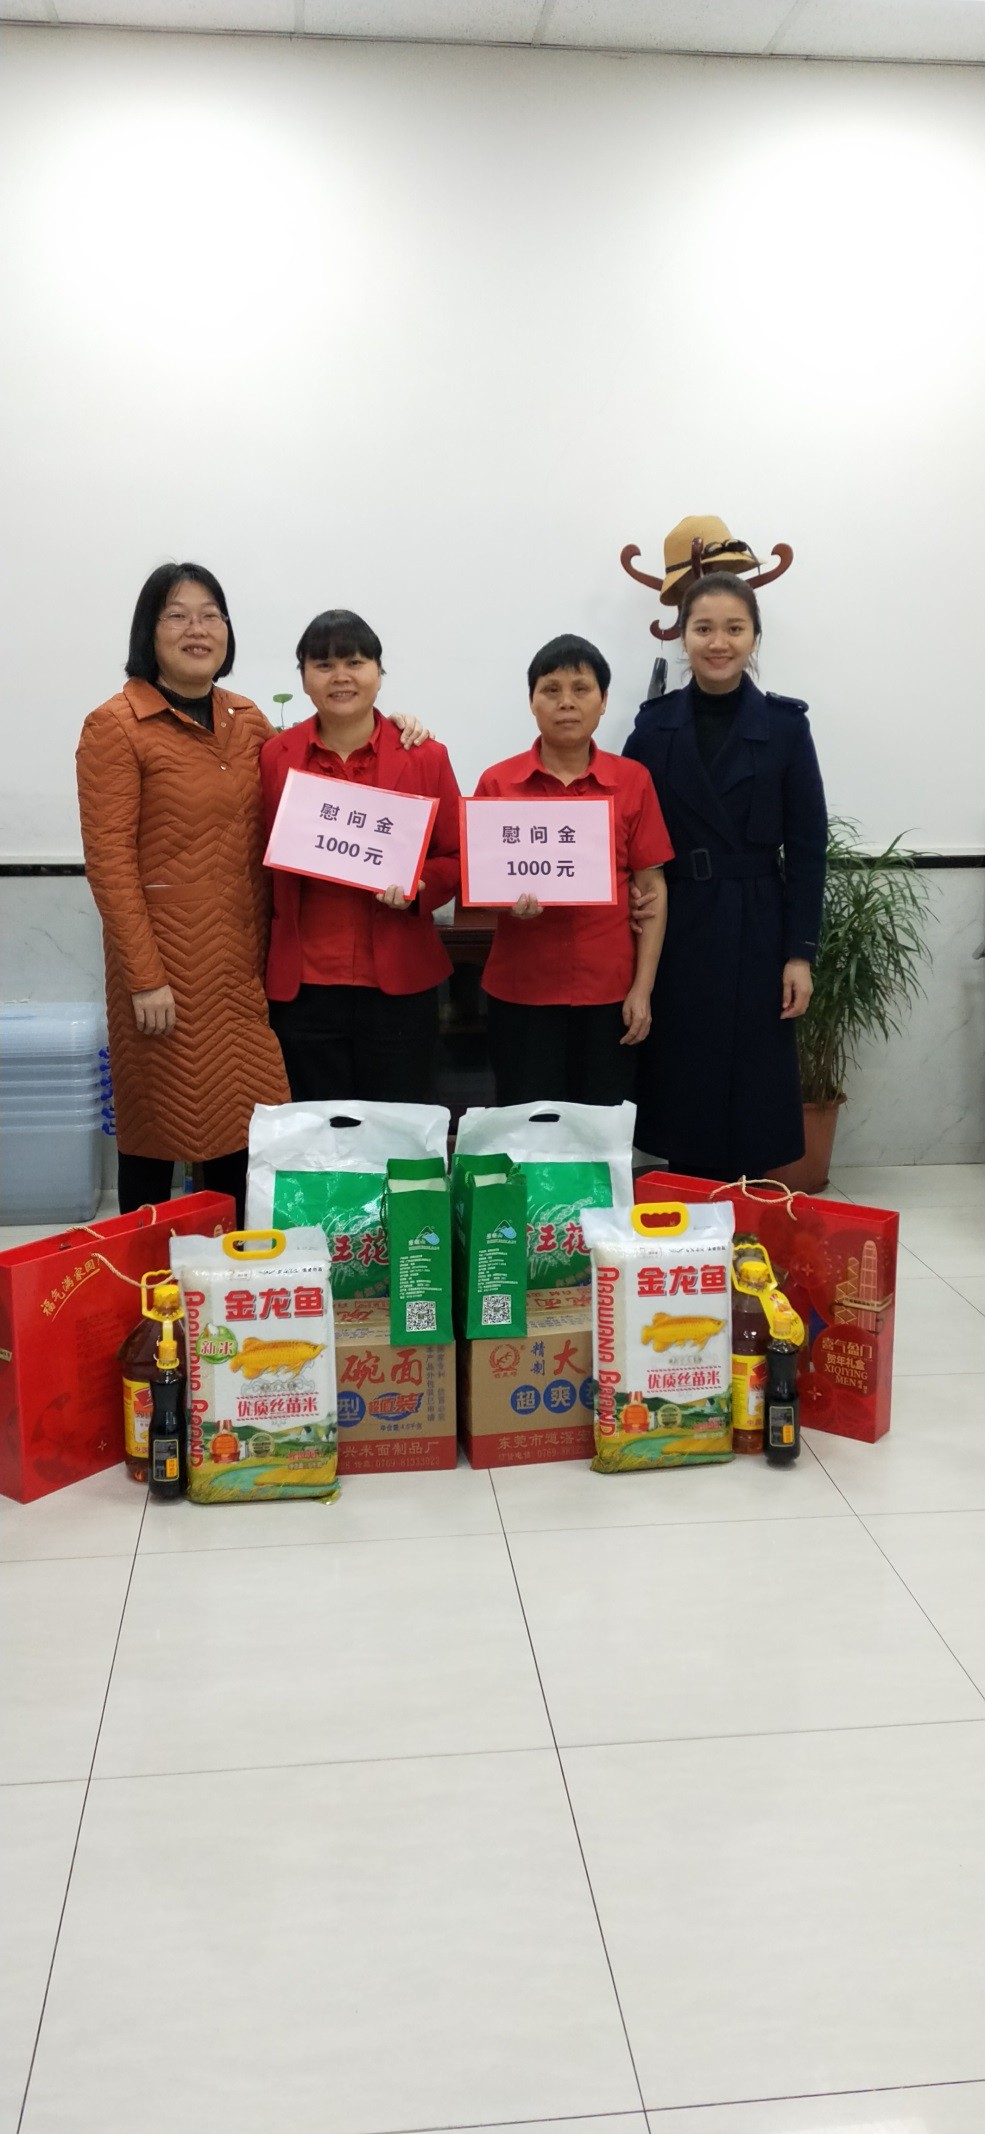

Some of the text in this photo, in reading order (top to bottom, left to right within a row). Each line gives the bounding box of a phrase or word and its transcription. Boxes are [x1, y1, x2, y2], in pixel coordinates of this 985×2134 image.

[319, 802, 395, 836] 慰问金
[502, 825, 576, 844] 慰问金
[637, 1264, 727, 1297] 金龙鱼
[225, 1286, 325, 1321] 金龙鱼
[201, 1340, 233, 1356] 新米
[530, 1341, 545, 1376] 精制
[553, 1339, 588, 1376] 大
[821, 1337, 873, 1359] 喜气盈门
[340, 1347, 423, 1390] 碗面
[824, 1363, 868, 1380] XIQIYING
[827, 1353, 865, 1371] 贺年礼盒
[648, 1370, 721, 1390] 优质丝苗米
[835, 1375, 856, 1387] MEN
[237, 1397, 318, 1418] 优质丝苗米
[343, 1441, 439, 1458] 兴米面制品厂
